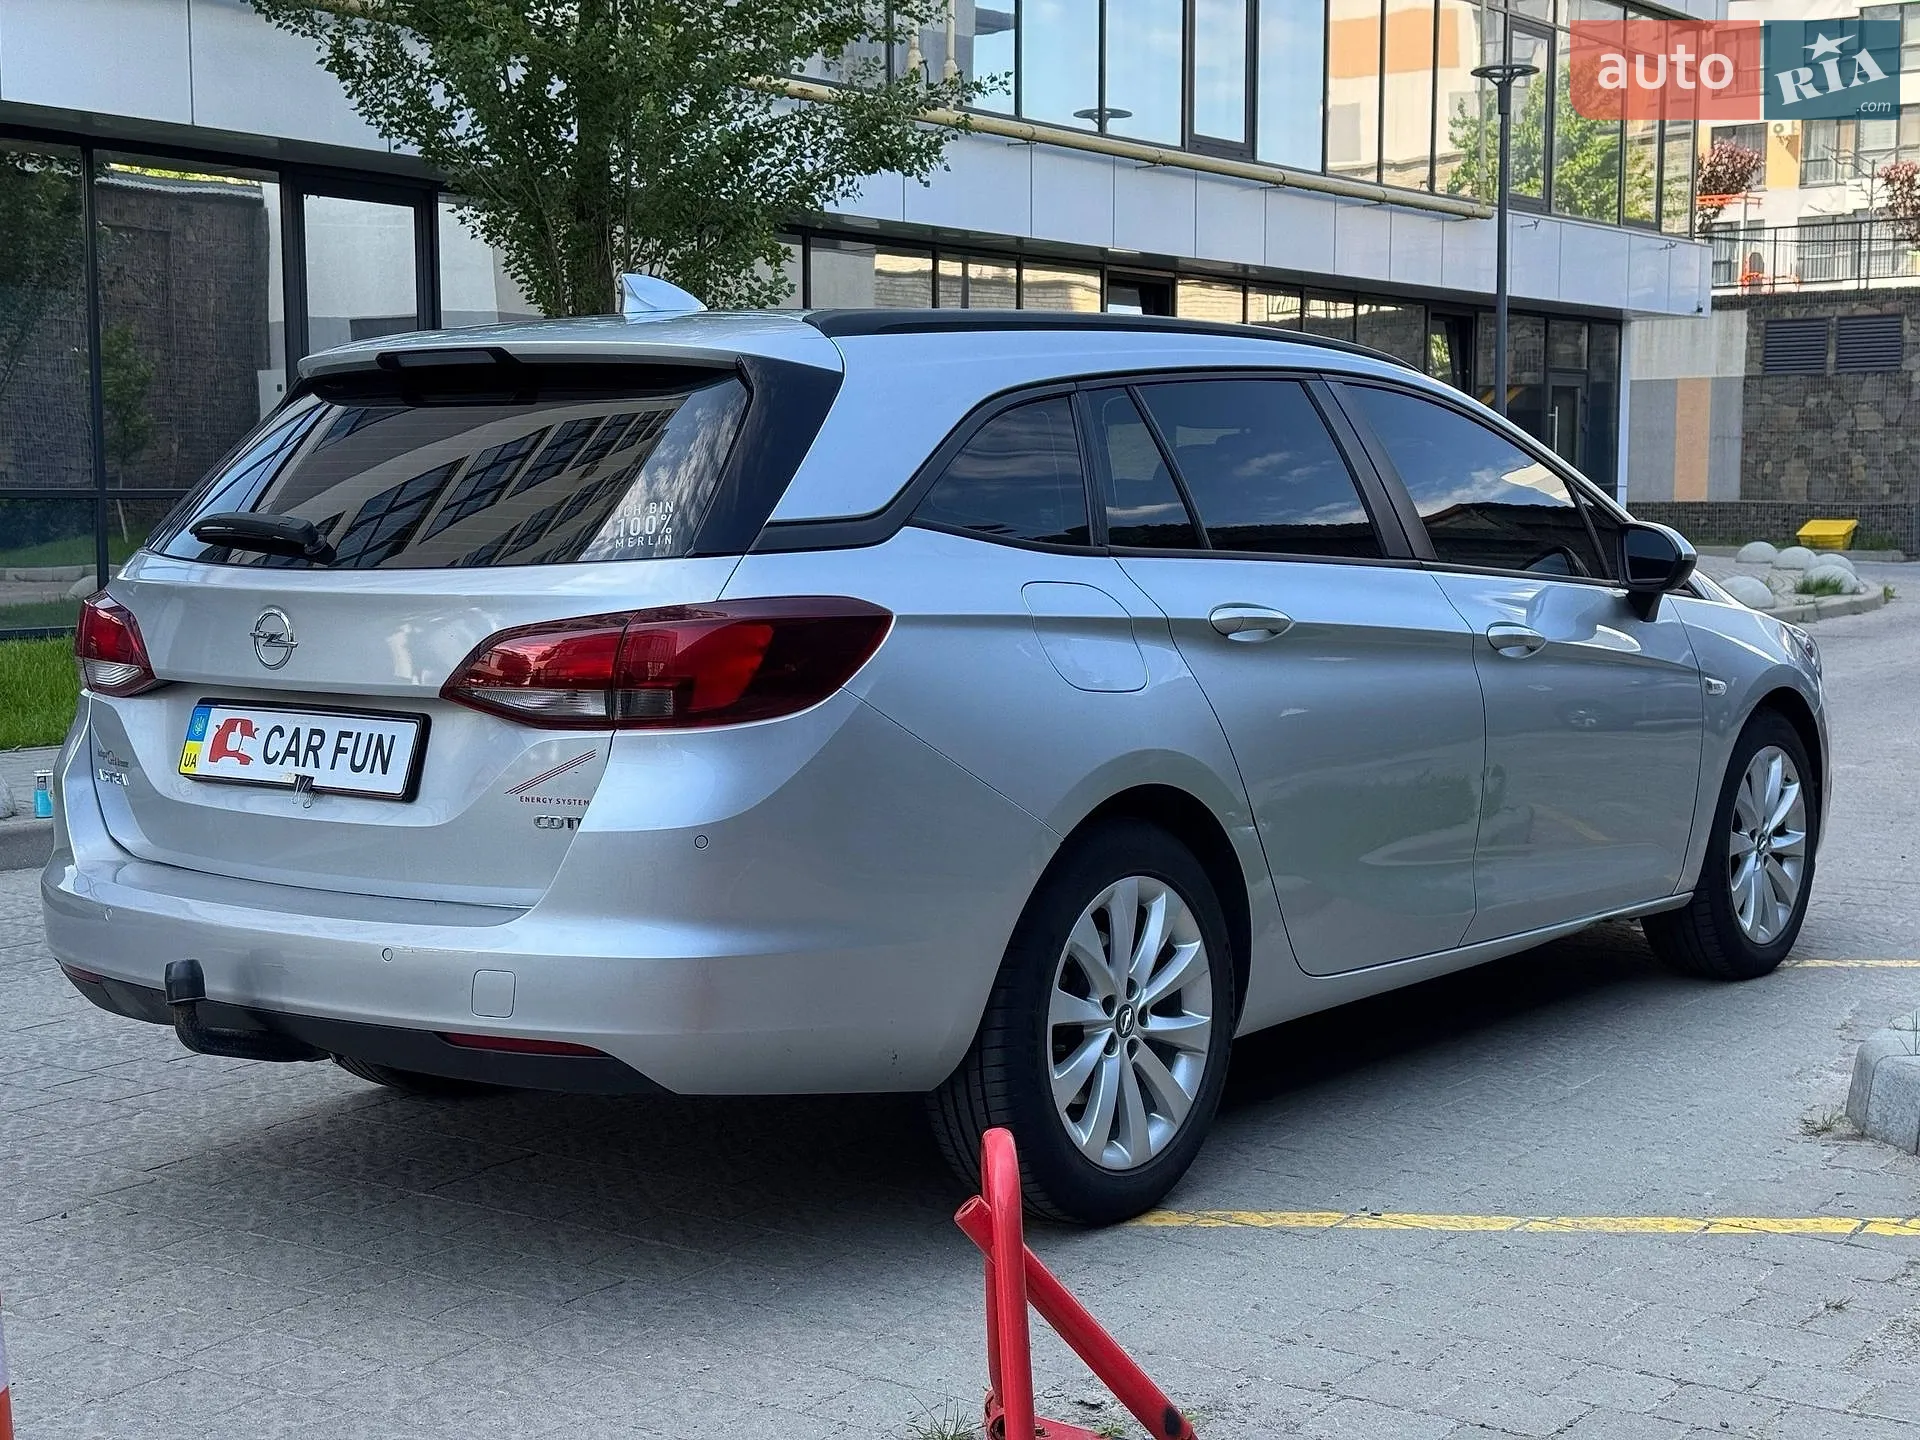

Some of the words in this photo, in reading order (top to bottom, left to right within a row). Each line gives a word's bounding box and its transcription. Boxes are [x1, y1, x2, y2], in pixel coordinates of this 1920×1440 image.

[649, 501, 674, 514] BIN
[617, 513, 673, 538] 100%
[615, 534, 673, 549] MERLIN
[262, 725, 326, 769] CAR
[329, 730, 396, 775] FUN
[183, 752, 198, 768] UA
[519, 795, 553, 805] ENERGY
